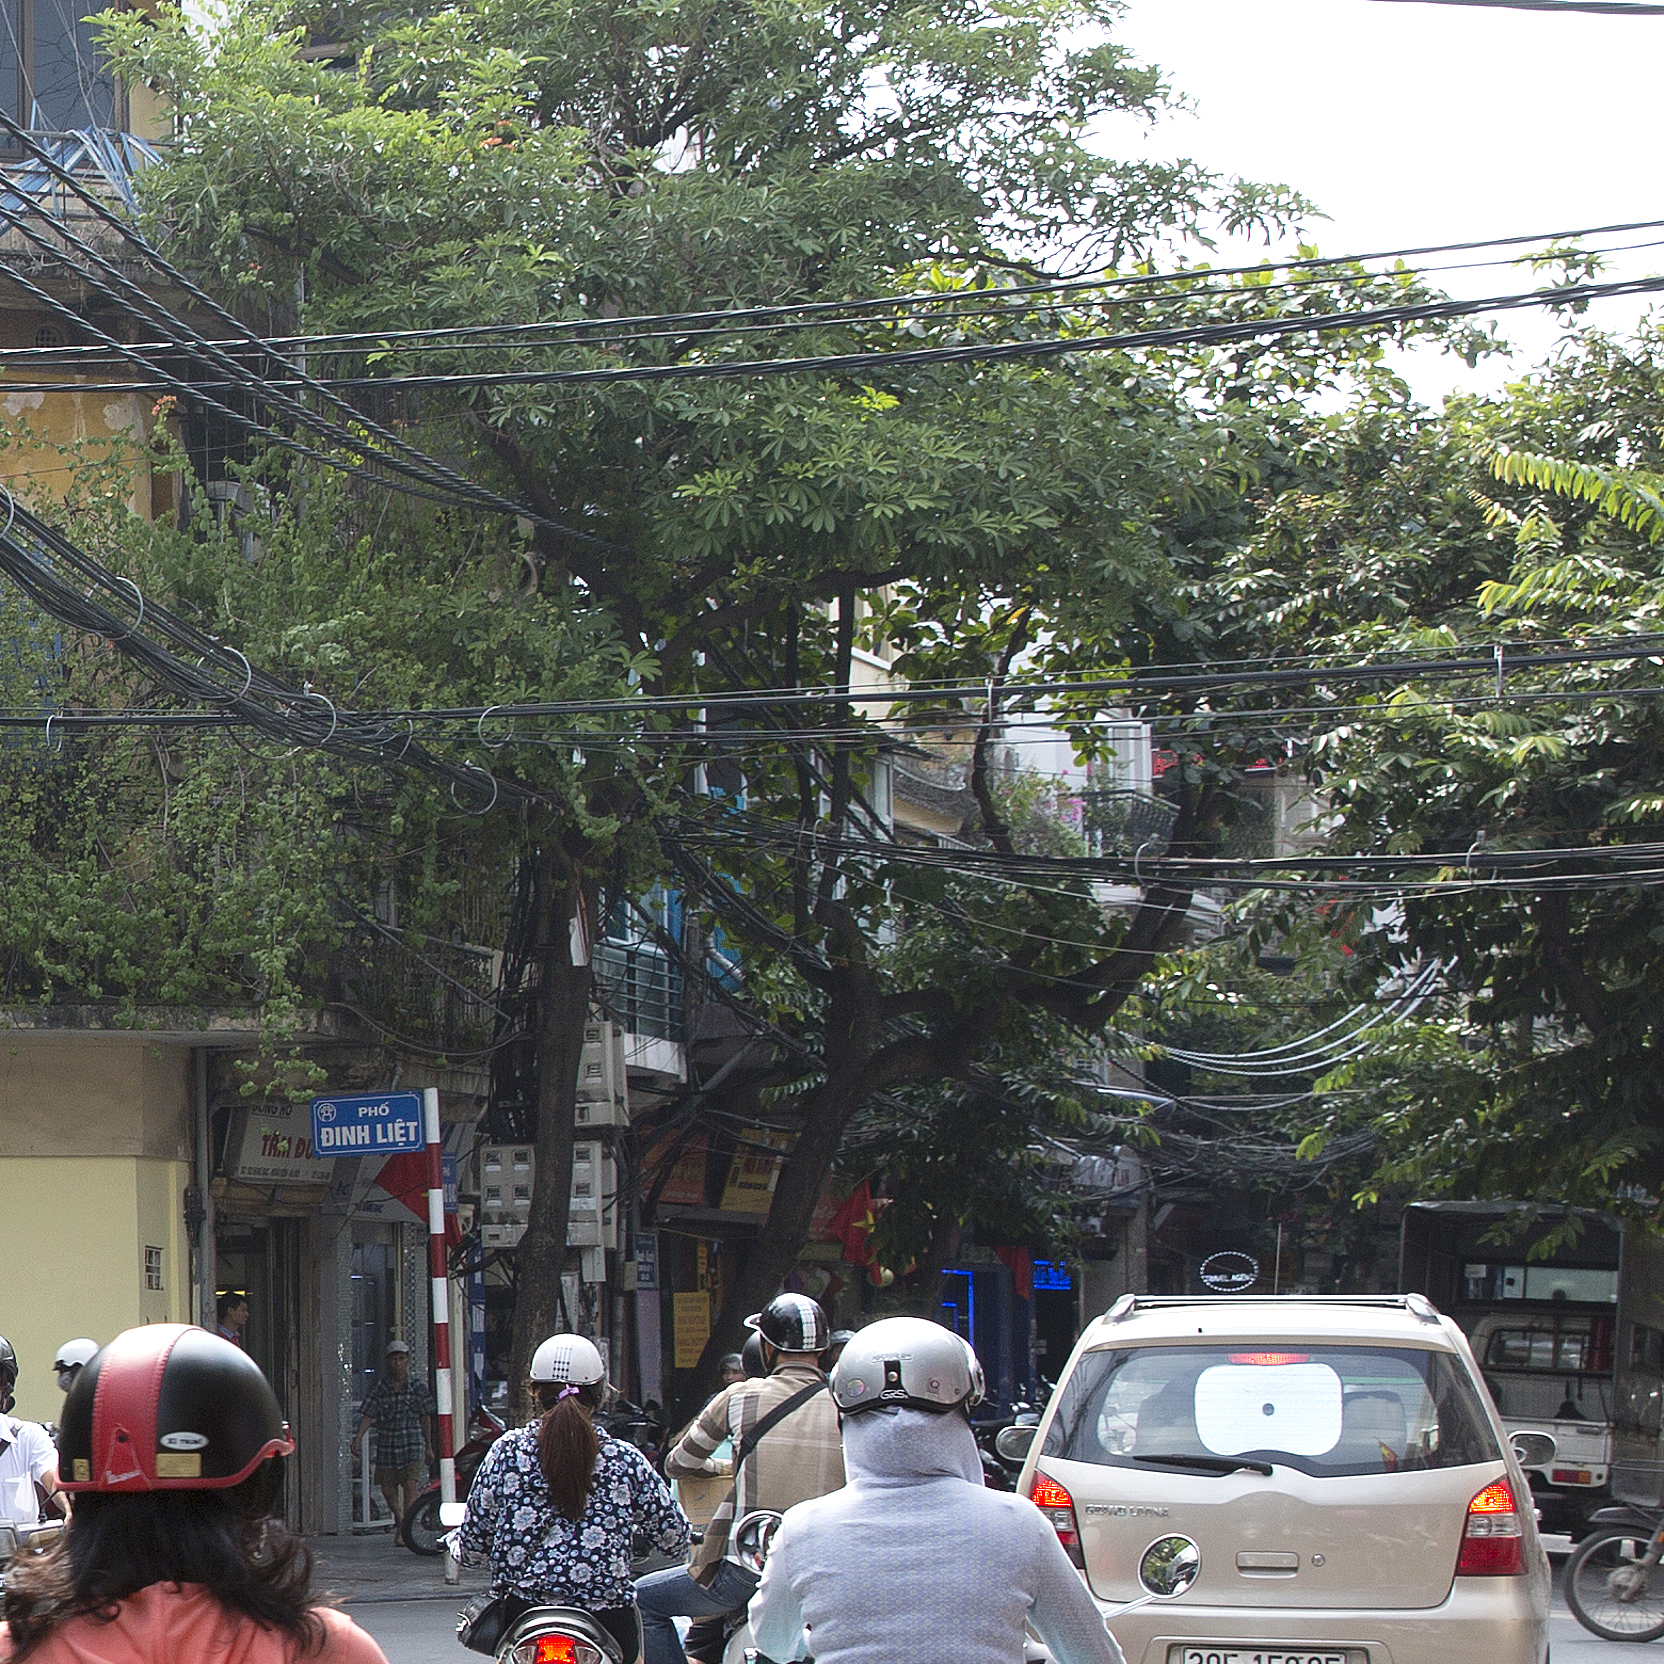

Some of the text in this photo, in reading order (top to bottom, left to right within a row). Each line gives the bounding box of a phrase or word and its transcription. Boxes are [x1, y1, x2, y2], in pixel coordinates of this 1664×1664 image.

[358, 1102, 390, 1118] PHỐ
[321, 1118, 418, 1147] ĐINH LIỆT
